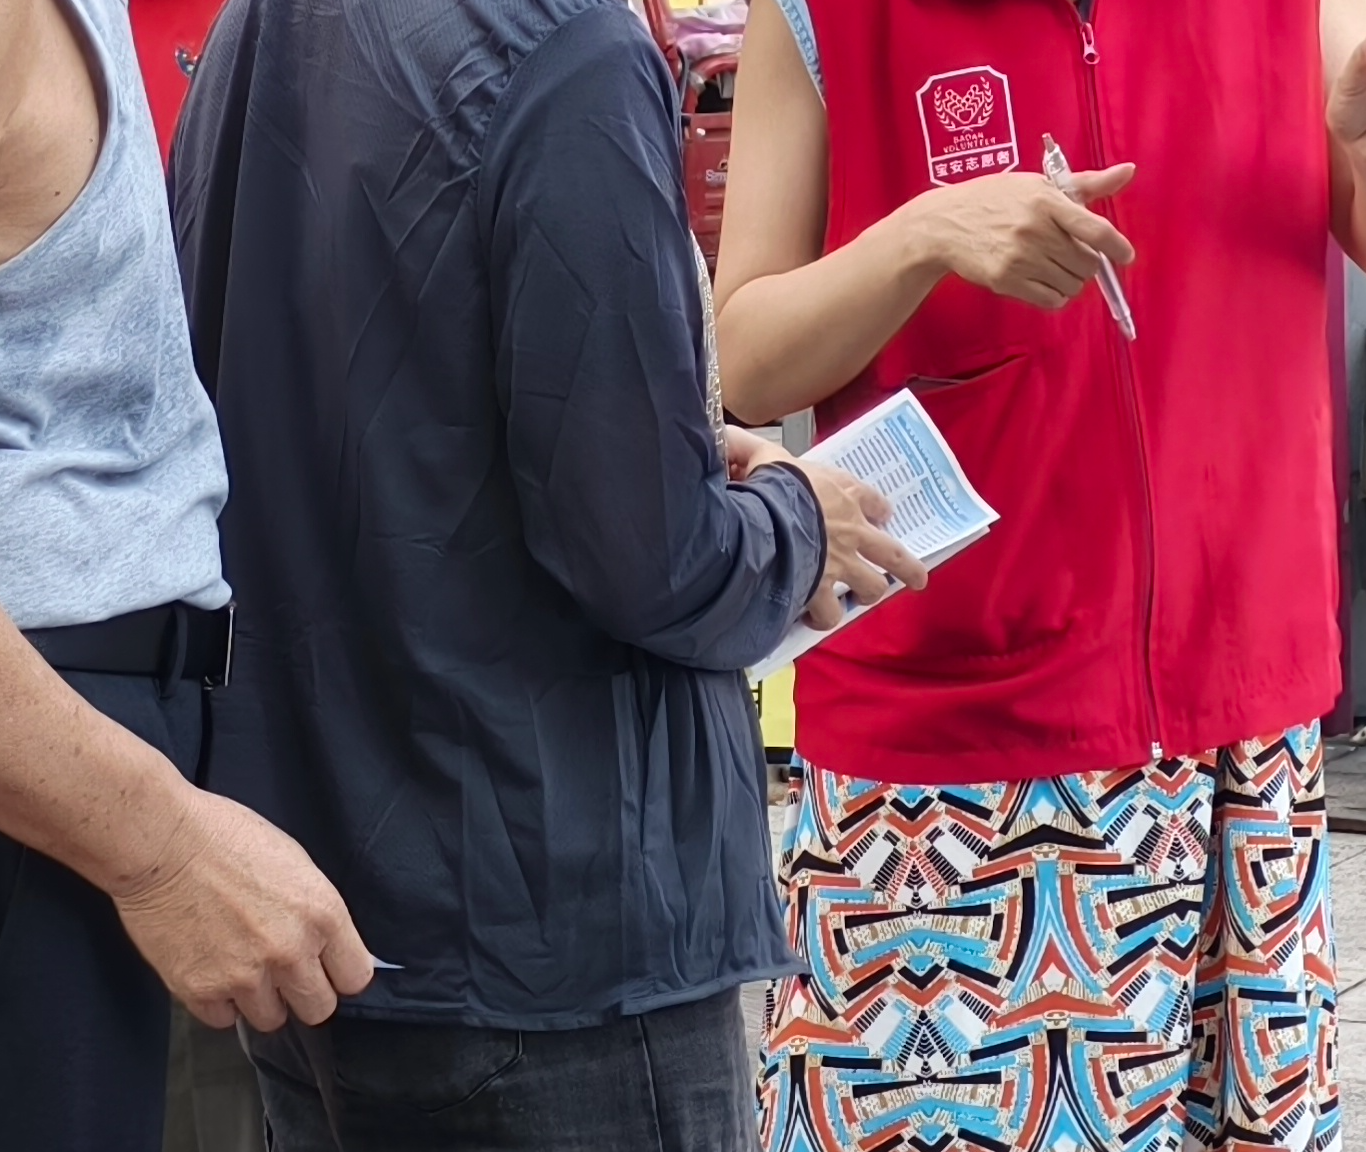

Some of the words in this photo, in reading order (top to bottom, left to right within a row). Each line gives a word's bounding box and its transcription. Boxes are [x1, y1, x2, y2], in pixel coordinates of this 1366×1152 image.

[935, 150, 1010, 178] 宝安志愿者
